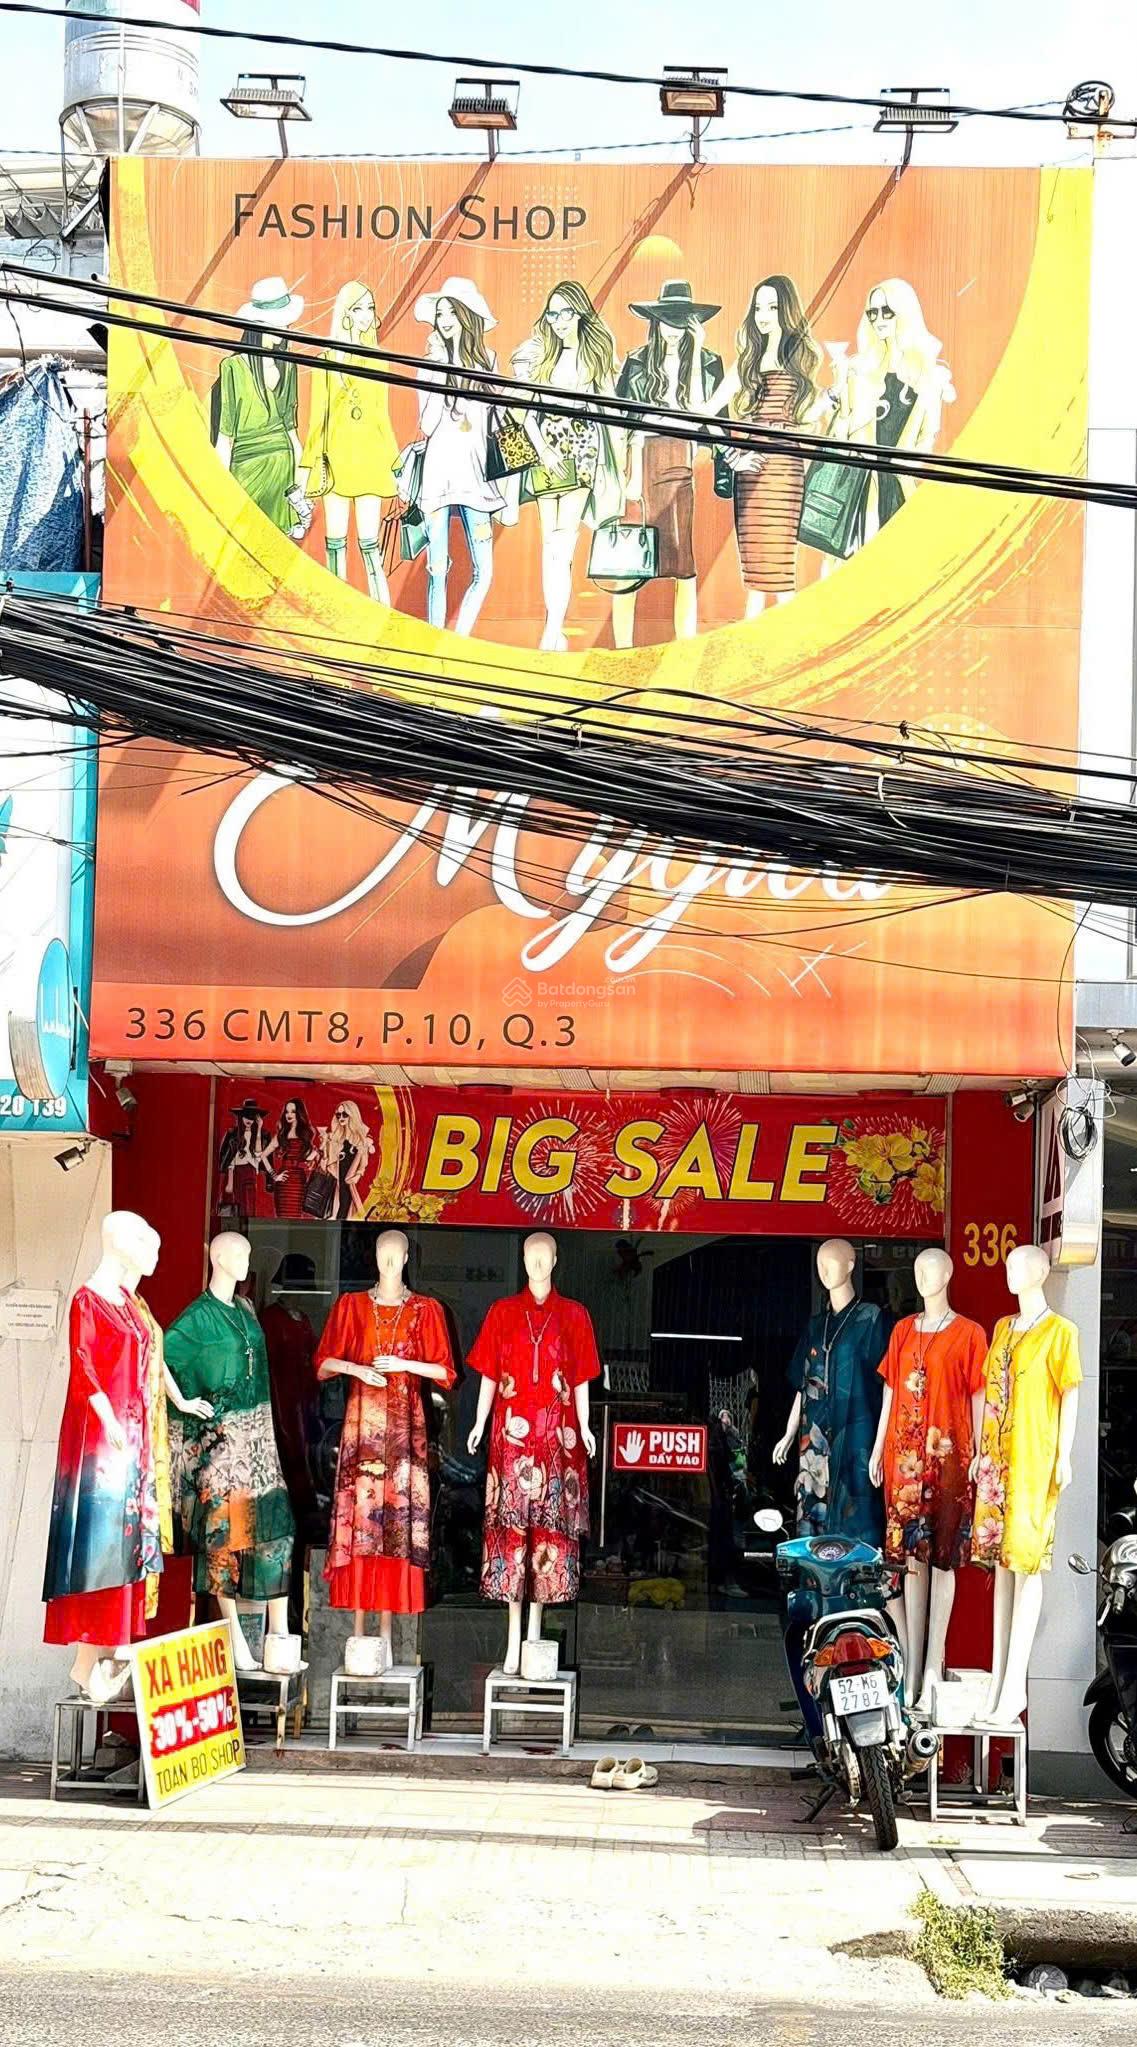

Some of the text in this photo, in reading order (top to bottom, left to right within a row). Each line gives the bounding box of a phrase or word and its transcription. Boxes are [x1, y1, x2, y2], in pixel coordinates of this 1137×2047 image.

[125, 1007, 577, 1051] 336 CMT8, P.10, Q.3
[421, 1113, 840, 1202] BIG SALE
[963, 1222, 1018, 1266] 336
[649, 1431, 700, 1453] PUSH
[841, 1690, 881, 1711] 2782
[211, 1738, 240, 1771] SHOP
